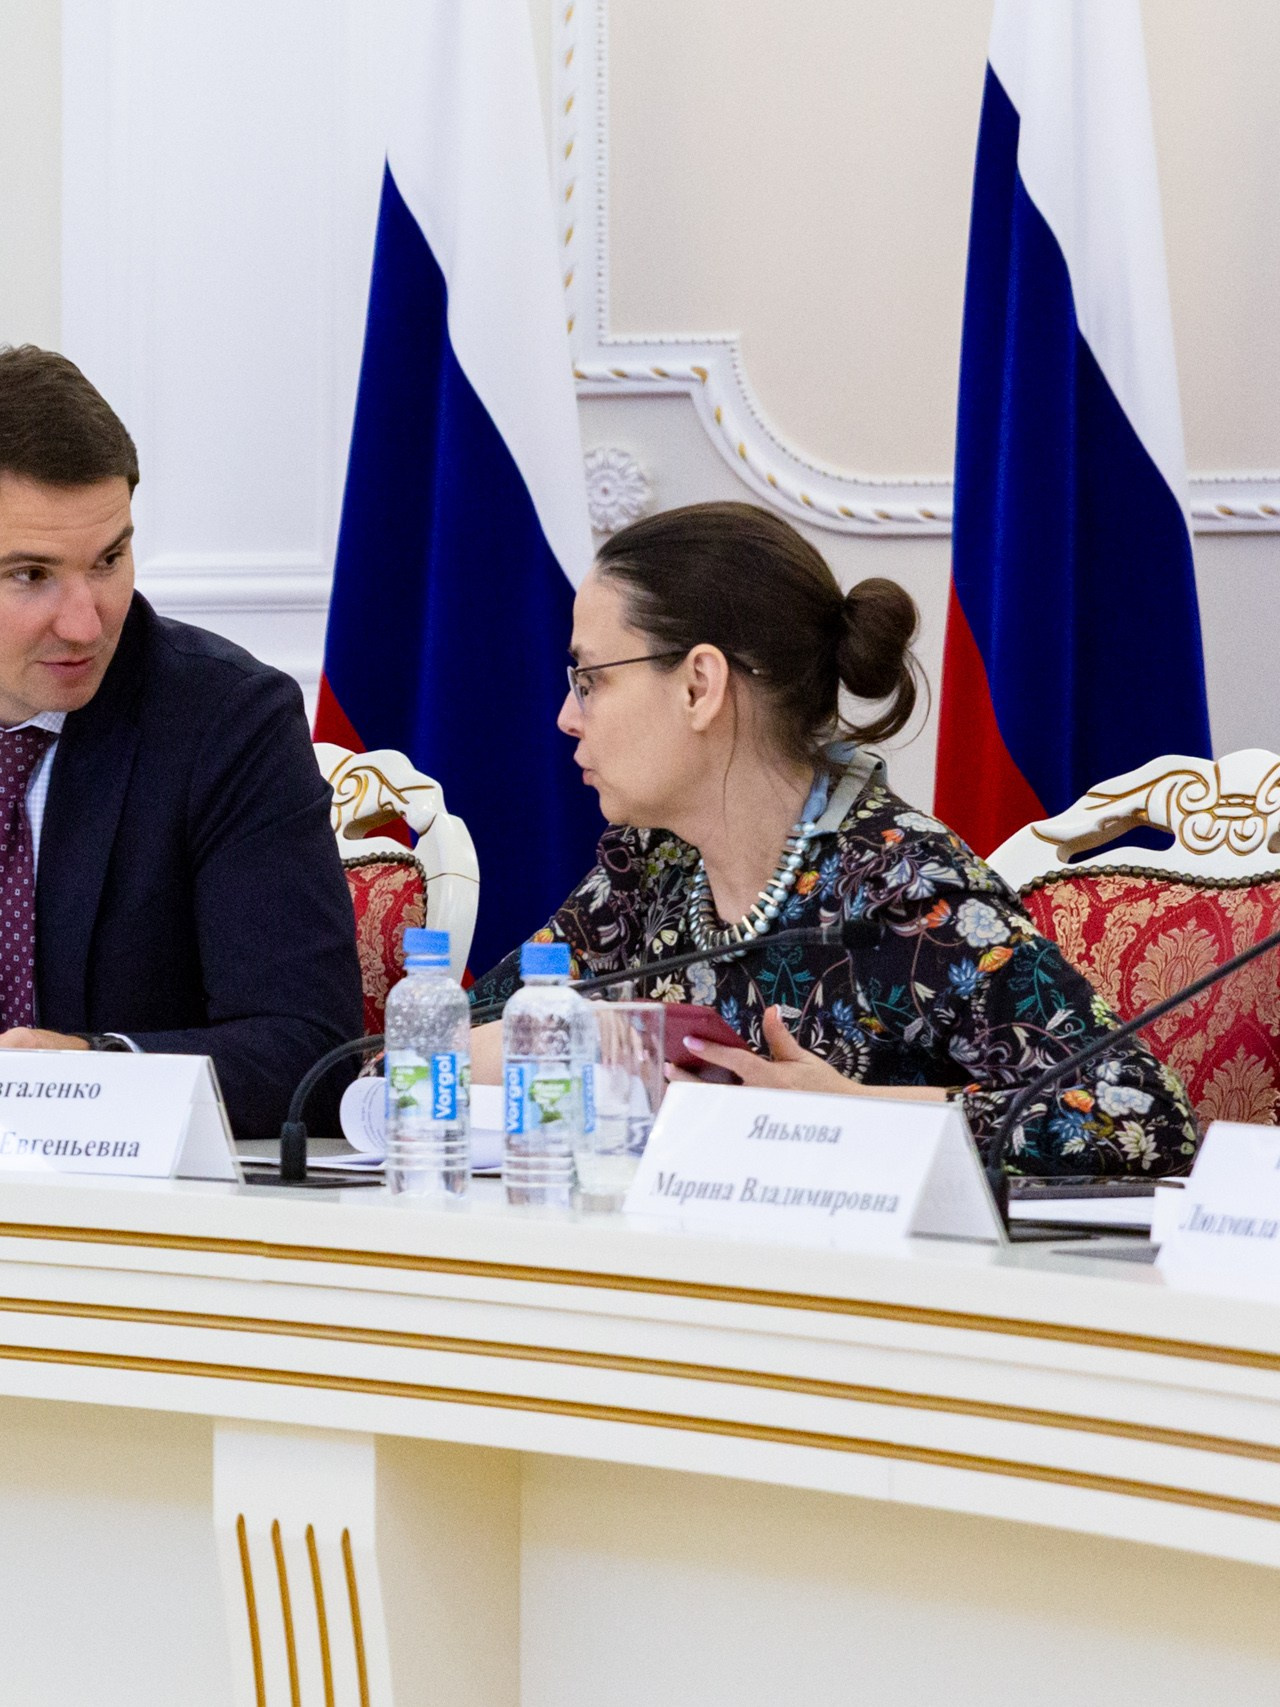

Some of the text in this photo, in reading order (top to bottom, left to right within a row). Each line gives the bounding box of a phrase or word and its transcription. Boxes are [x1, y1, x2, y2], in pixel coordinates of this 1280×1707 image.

[434, 1055, 455, 1118] Vorgol
[506, 1066, 523, 1132] Vorgol
[748, 1114, 843, 1145] Янькова
[651, 1172, 900, 1217] Марина Владимировна
